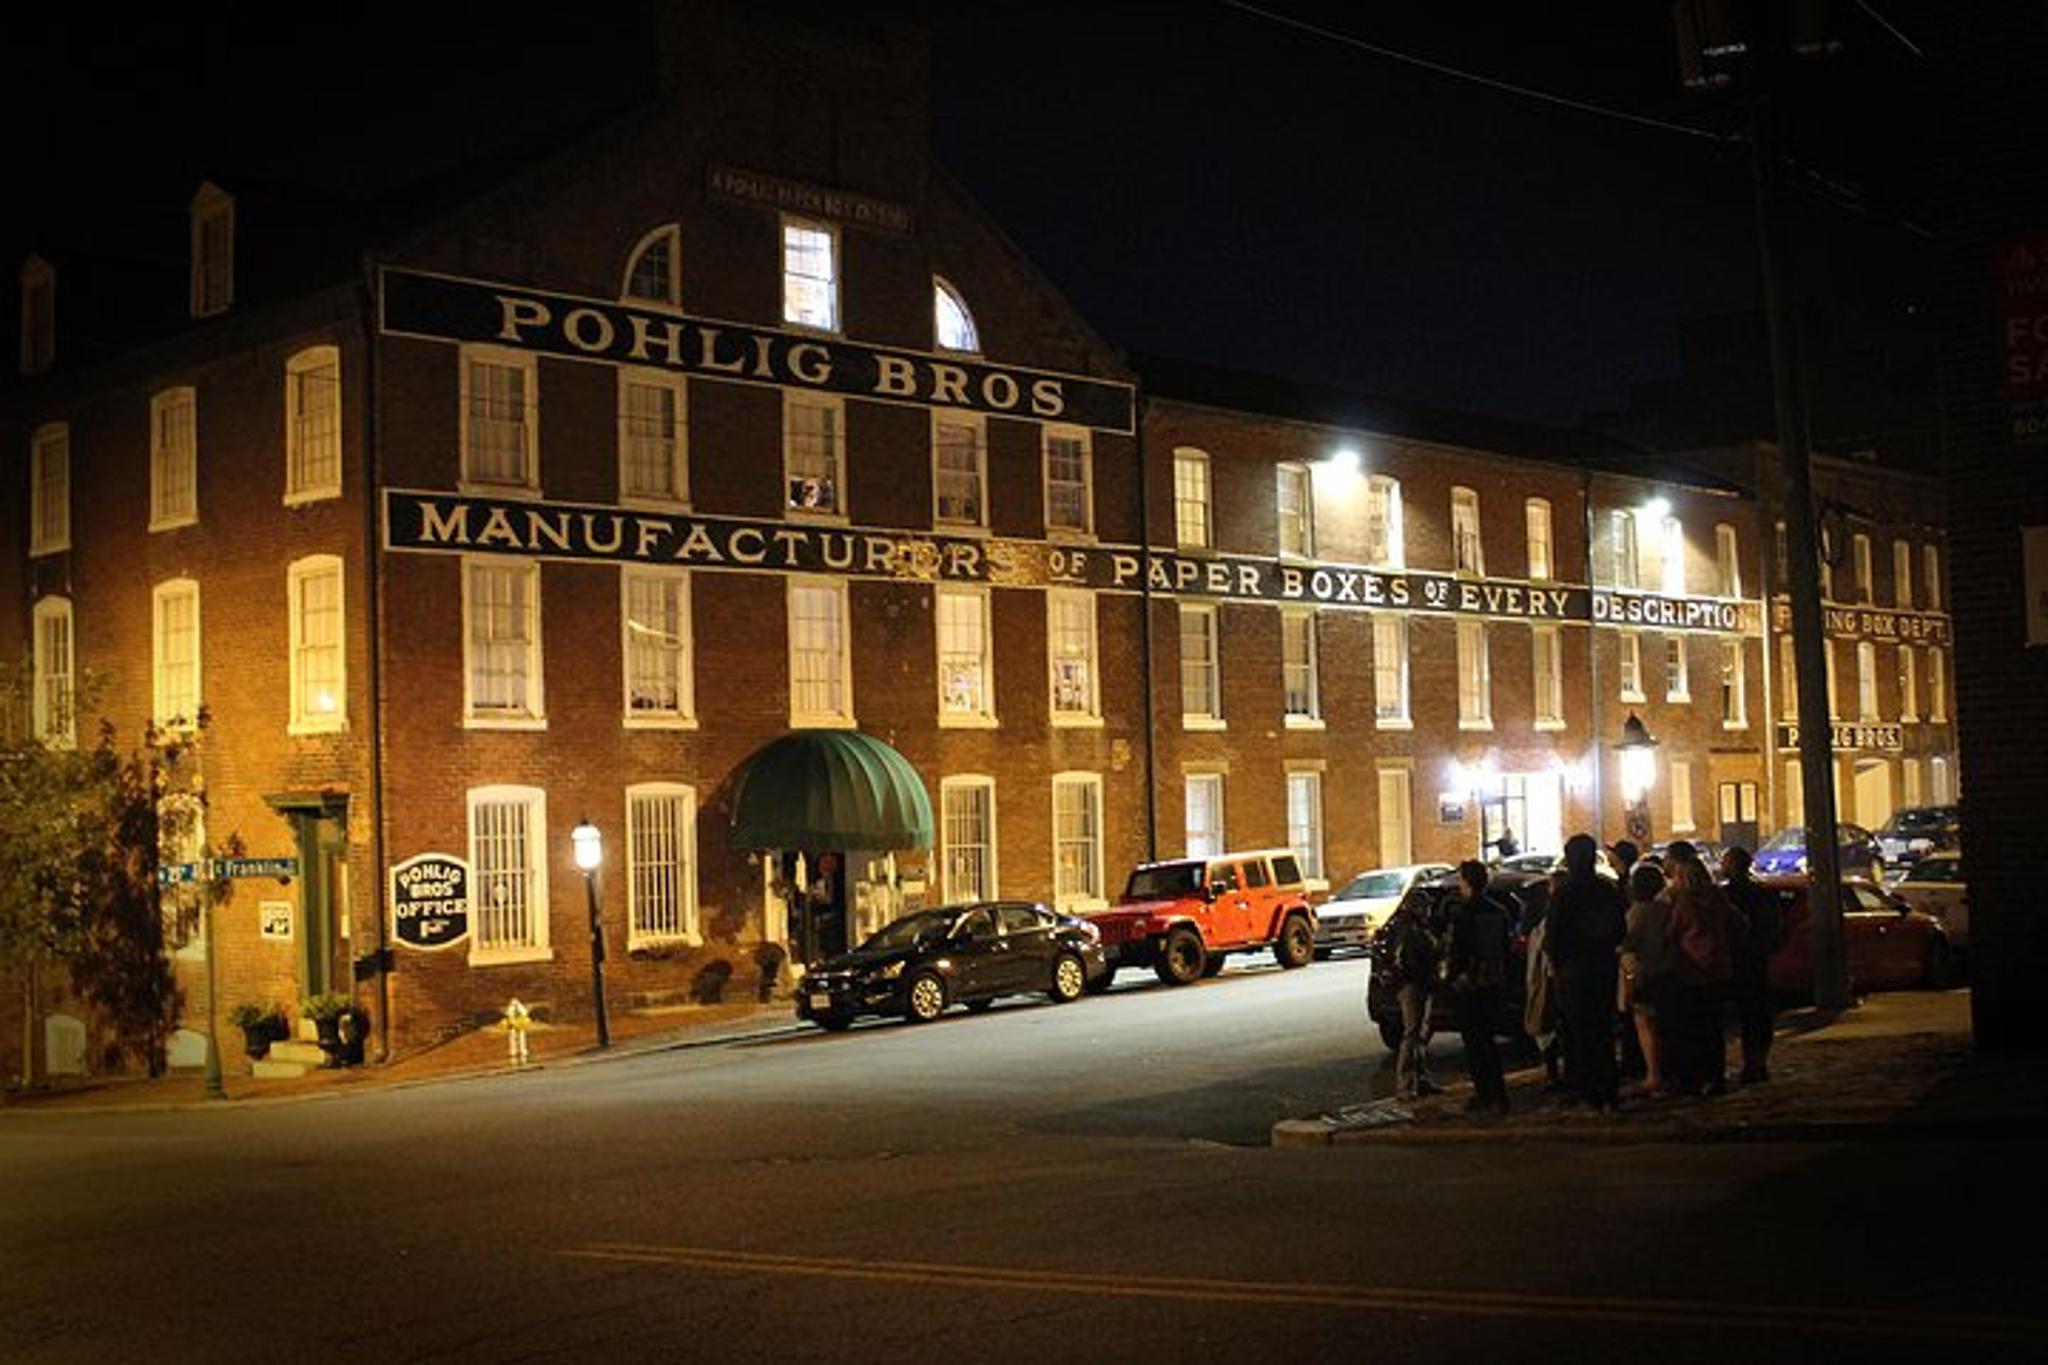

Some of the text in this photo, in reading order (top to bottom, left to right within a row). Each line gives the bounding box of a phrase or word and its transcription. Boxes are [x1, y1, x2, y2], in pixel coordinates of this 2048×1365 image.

[496, 296, 1064, 417] POHLIG BROS
[1050, 551, 1087, 574] OF
[1112, 555, 1262, 597] PAPER
[1282, 568, 1409, 605] BOXES
[1425, 582, 1448, 600] OF
[1461, 585, 1569, 617] EVERY
[1862, 613, 1895, 636] BOX
[399, 864, 462, 889] POHLIG
[410, 881, 454, 899] BROS
[397, 898, 467, 919] OFFICE
